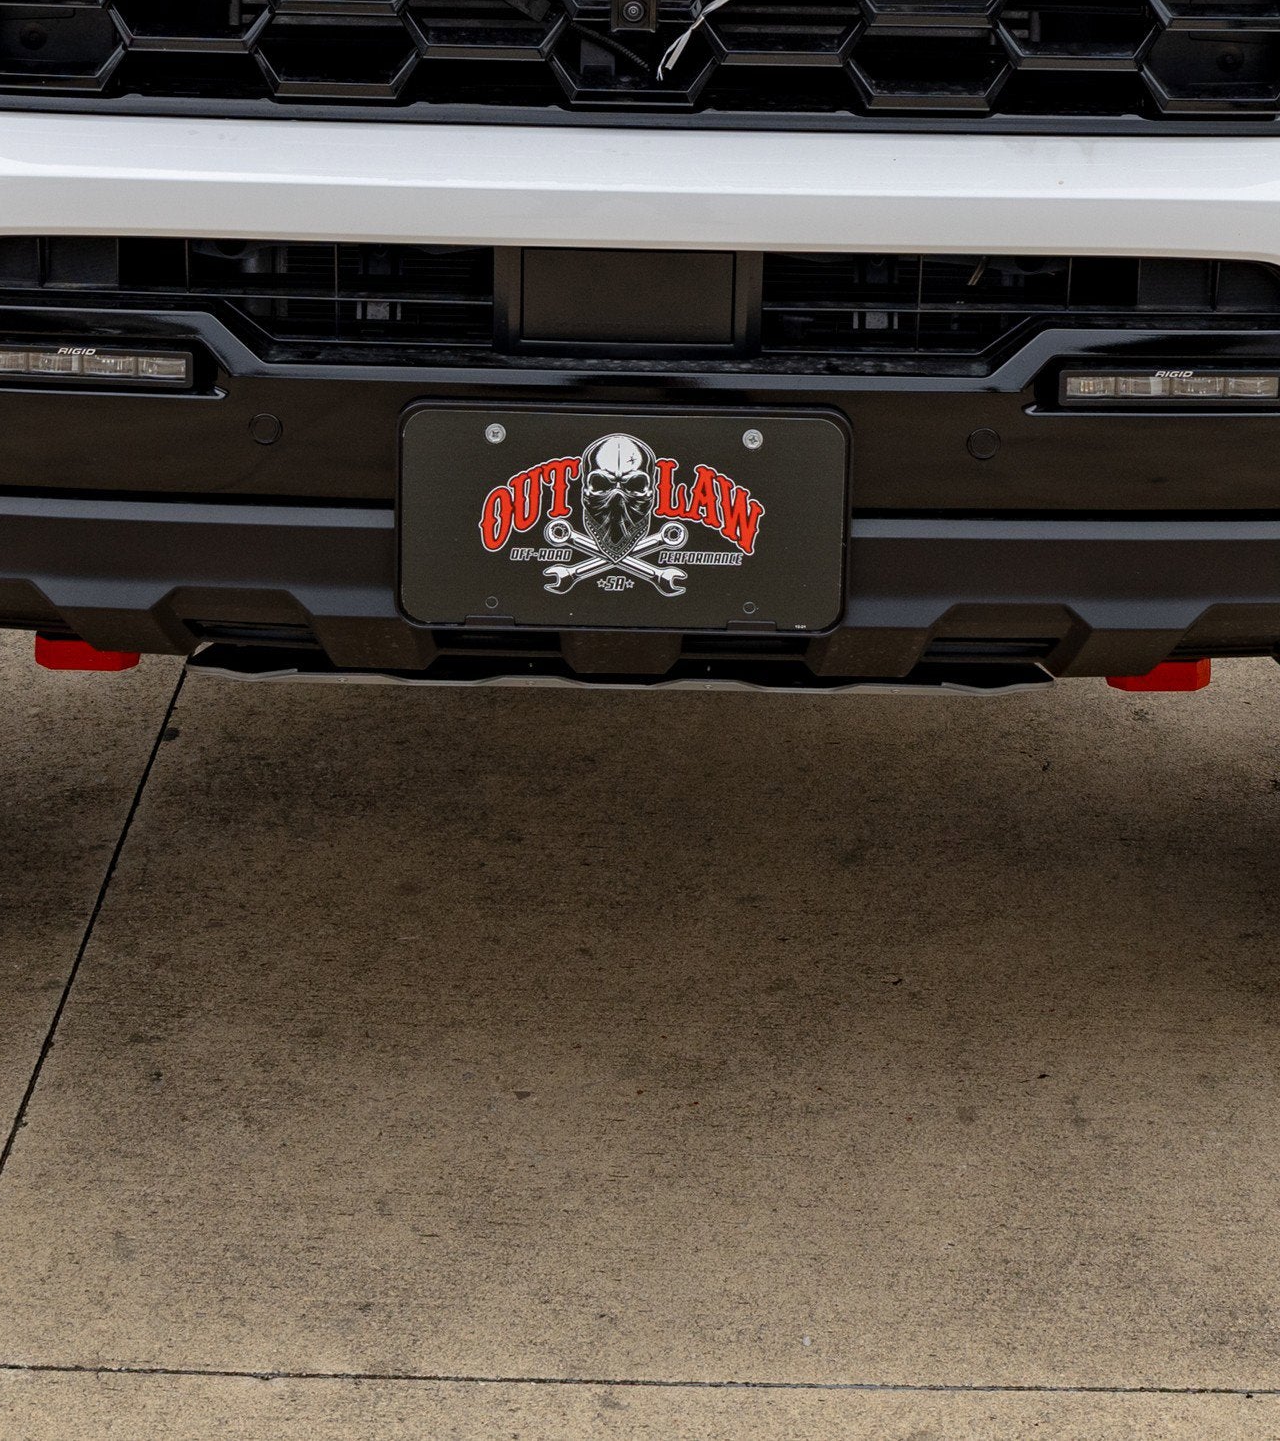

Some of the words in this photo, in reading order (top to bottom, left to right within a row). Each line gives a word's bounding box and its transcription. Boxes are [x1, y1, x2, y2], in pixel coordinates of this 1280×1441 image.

[57, 348, 96, 356] RIGID
[478, 456, 582, 552] OUT
[653, 457, 765, 555] LAW
[509, 547, 573, 562] OFF-ROAD
[658, 551, 745, 566] PERFORMANCE
